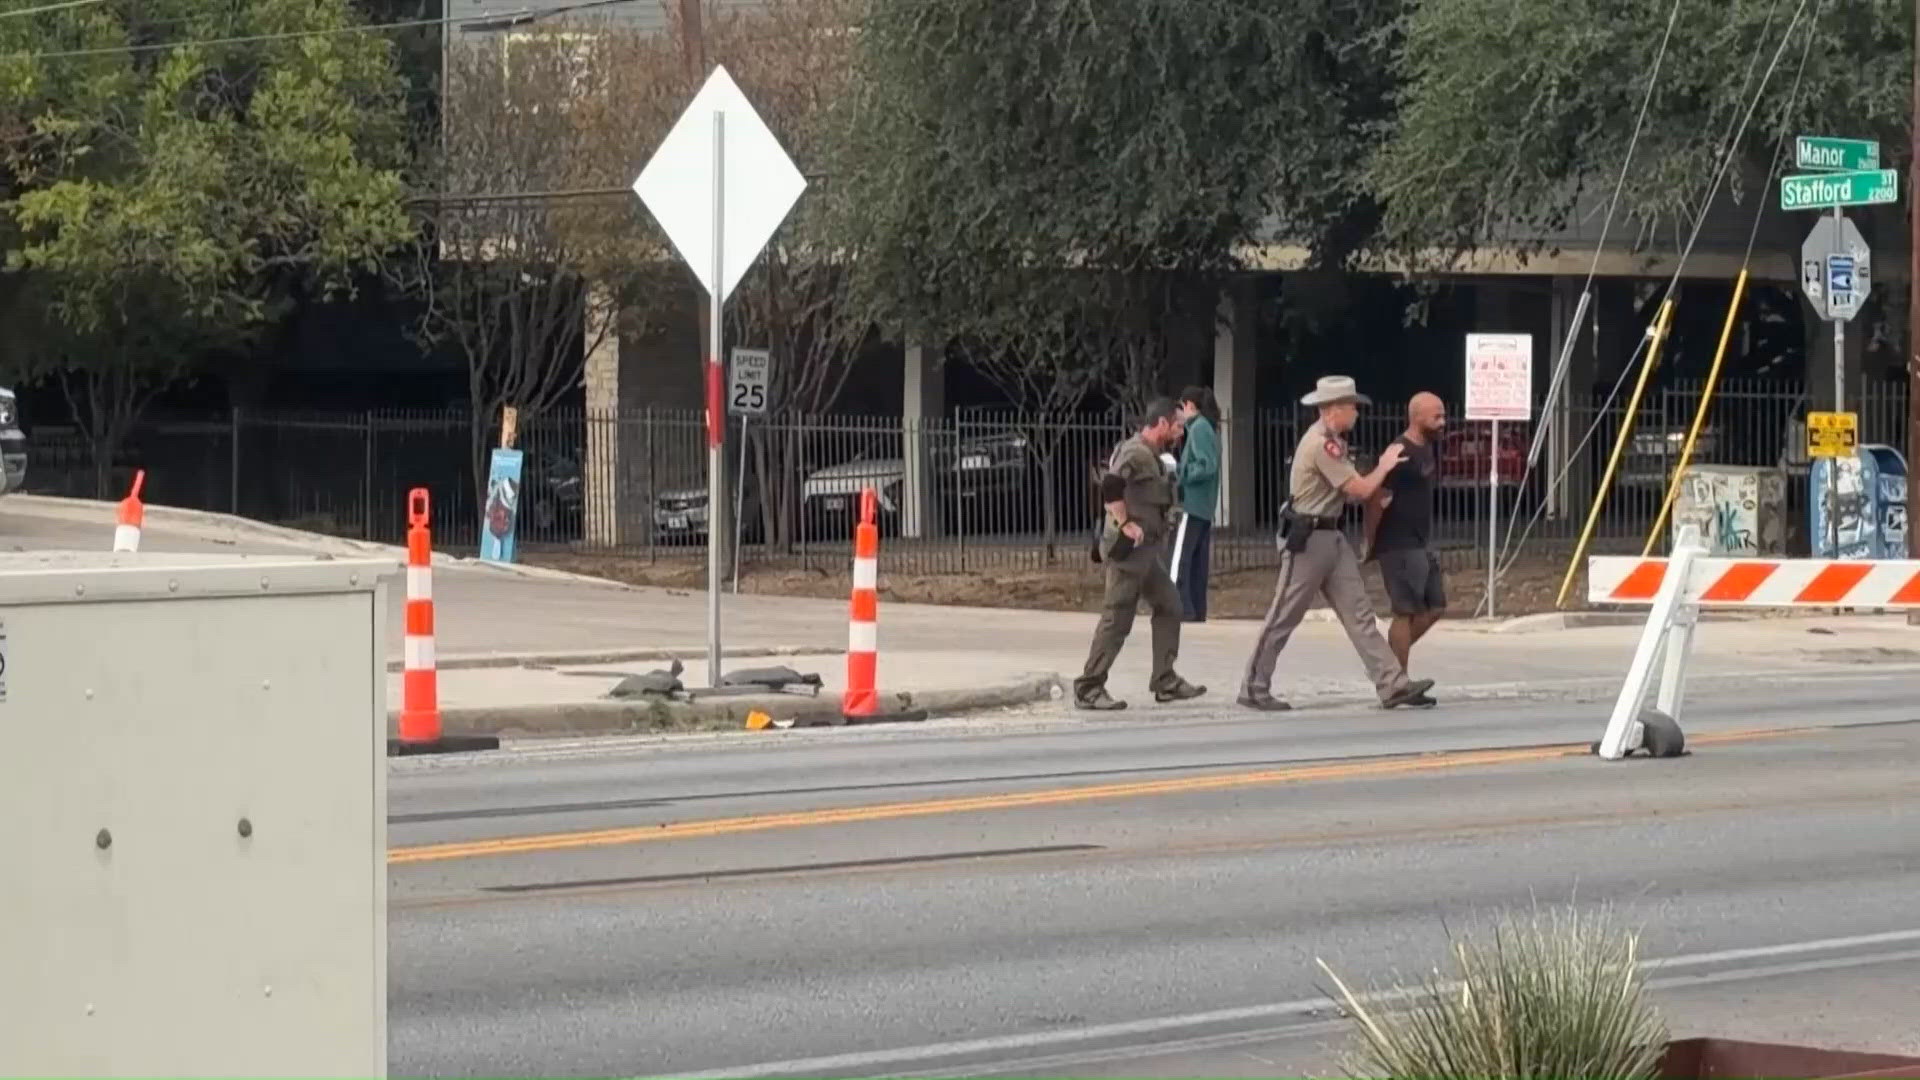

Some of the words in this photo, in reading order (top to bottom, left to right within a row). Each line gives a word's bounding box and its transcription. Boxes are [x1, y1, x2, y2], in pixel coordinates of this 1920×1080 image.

[1800, 142, 1845, 166] Manor
[1785, 178, 1852, 205] Stafford
[736, 354, 766, 368] SPEED
[738, 370, 761, 380] LIMIT
[734, 384, 764, 408] 25
